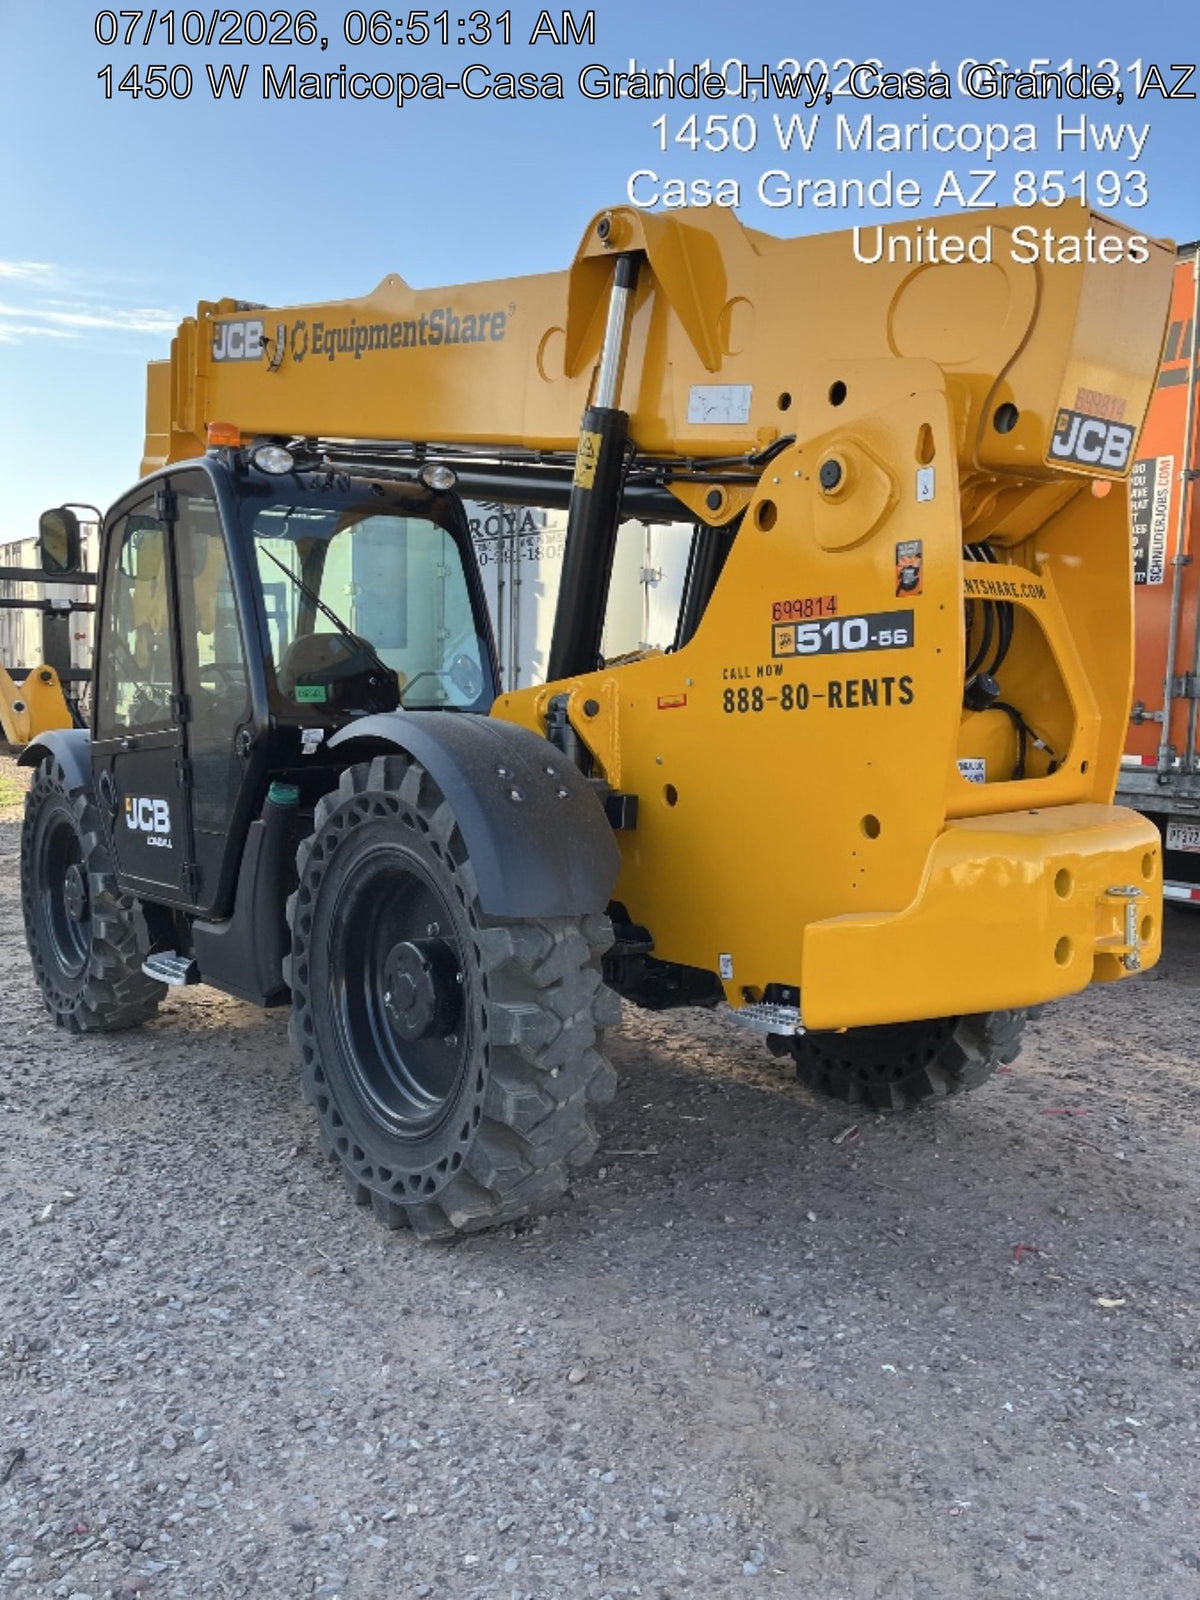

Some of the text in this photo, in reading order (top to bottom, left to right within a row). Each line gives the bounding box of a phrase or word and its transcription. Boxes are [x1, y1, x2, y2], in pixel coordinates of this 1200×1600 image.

[213, 320, 263, 361] JCB
[311, 308, 506, 362] EquipmentShare
[1052, 416, 1132, 467] JCB
[468, 510, 558, 538] ROYAL
[963, 578, 1046, 599] NTSHARE.COM
[772, 596, 837, 621] 699814
[796, 617, 908, 653] 510-56
[722, 664, 784, 680] CALL NOW
[723, 675, 914, 714] 888-80-RENTS
[125, 797, 171, 833] JCB
